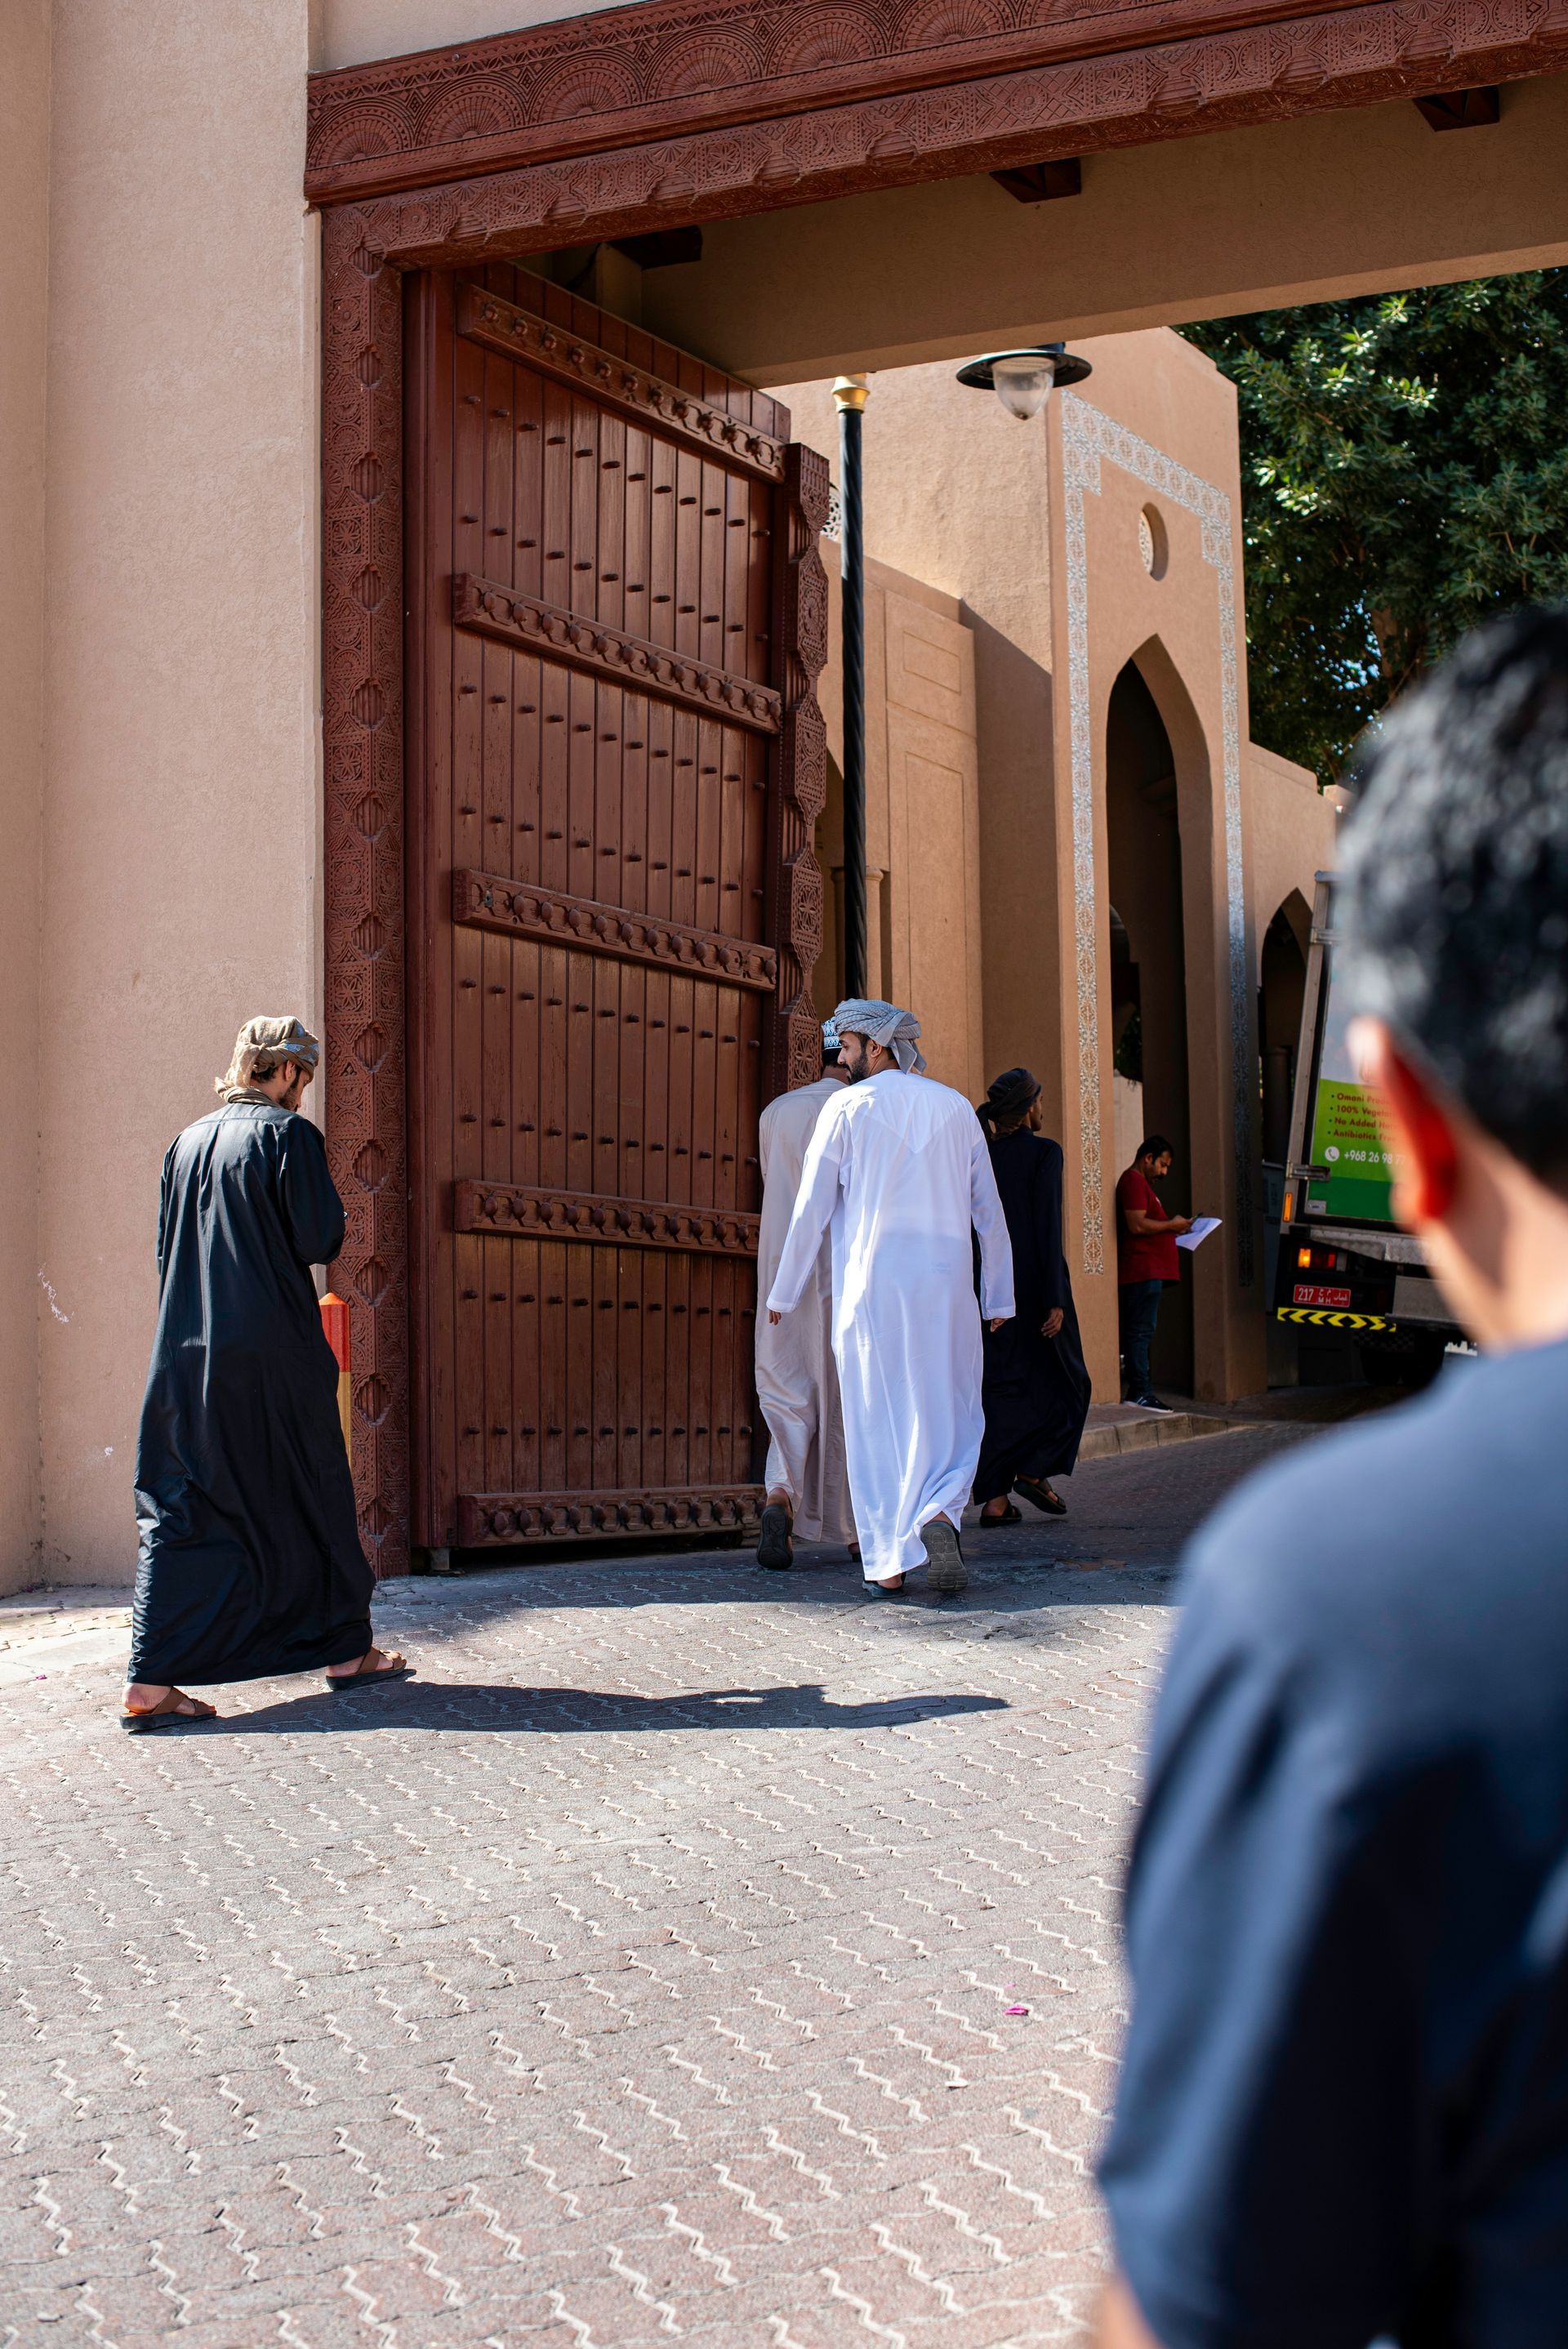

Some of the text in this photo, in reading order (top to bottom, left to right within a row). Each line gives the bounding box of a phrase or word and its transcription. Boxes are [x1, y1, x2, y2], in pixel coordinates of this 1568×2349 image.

[1337, 1092, 1364, 1103] Omani
[1337, 1104, 1358, 1114] 100%
[1334, 1117, 1347, 1125] No
[1350, 1118, 1376, 1128] Added
[1333, 1129, 1376, 1140] Antibiotics
[1343, 1149, 1366, 1161] +968
[1369, 1151, 1380, 1163] 26
[1382, 1152, 1393, 1165] 98
[1298, 1286, 1315, 1302] 217
